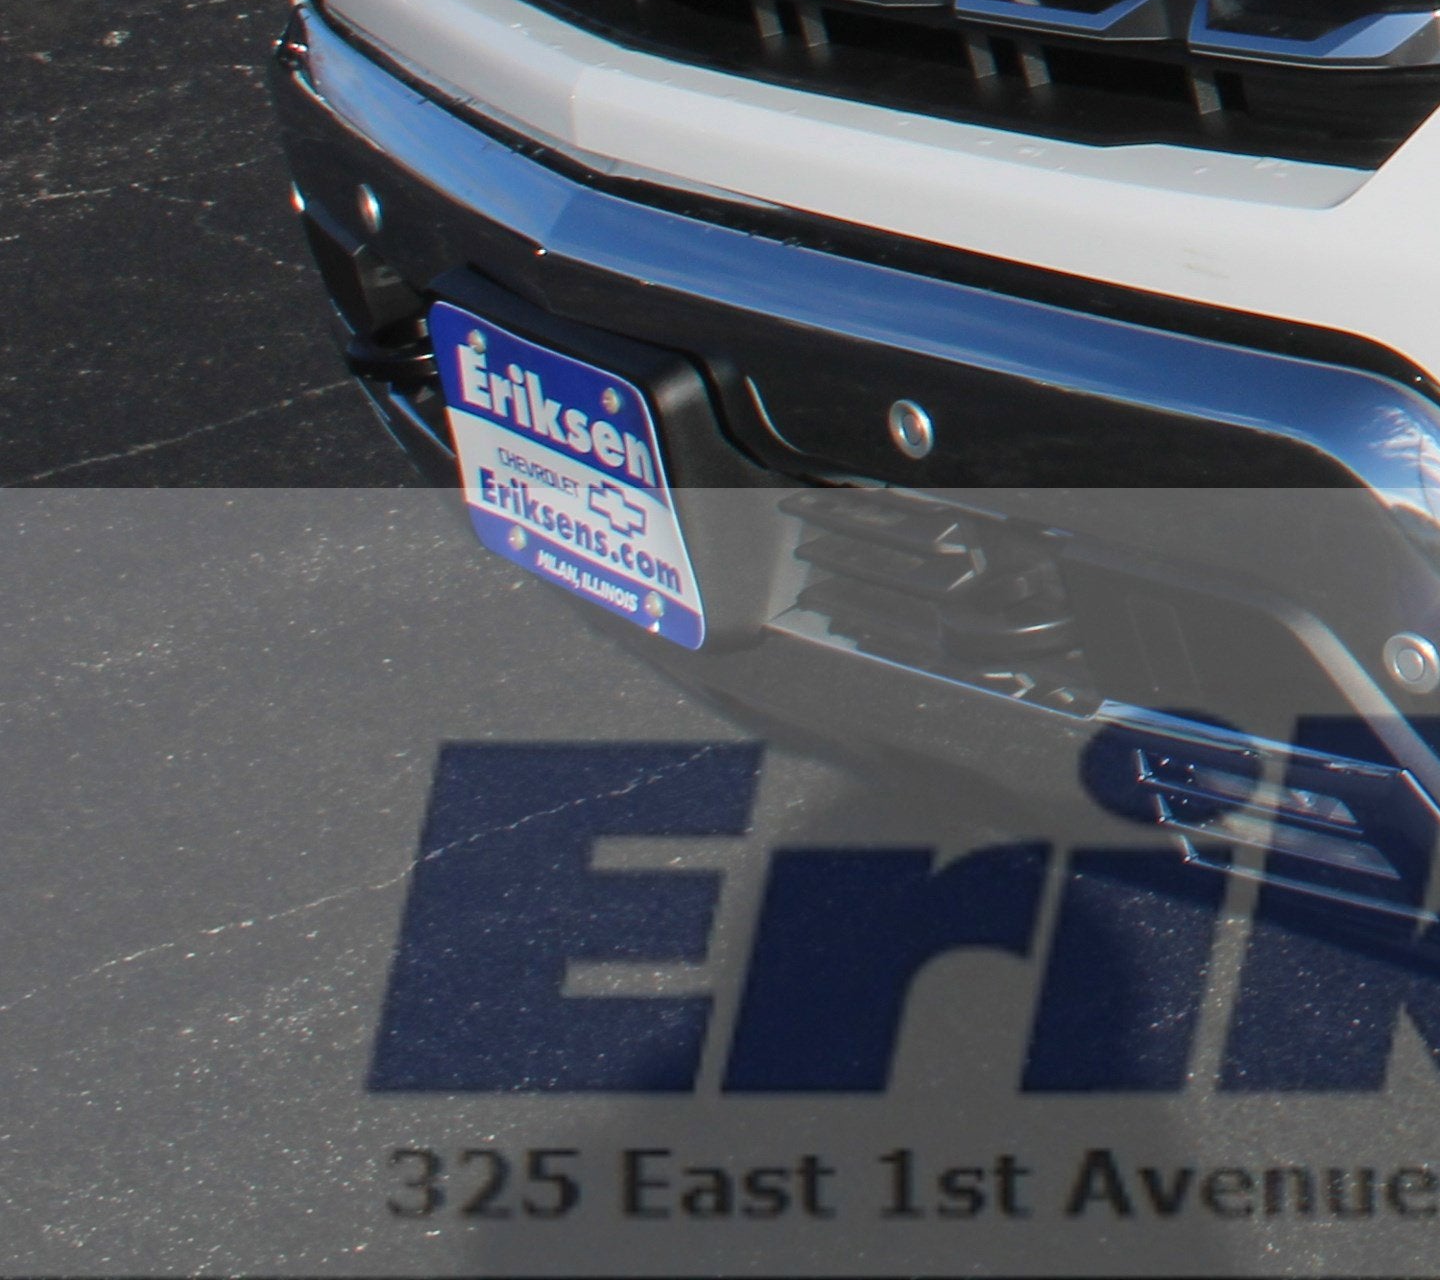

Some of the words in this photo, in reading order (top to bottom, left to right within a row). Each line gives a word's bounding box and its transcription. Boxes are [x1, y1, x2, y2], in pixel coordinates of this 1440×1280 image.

[456, 343, 656, 487] Eriksen
[498, 446, 580, 497] CHEVROLET
[479, 466, 683, 595] Eriksens.com
[581, 571, 639, 613] ILLINOIS
